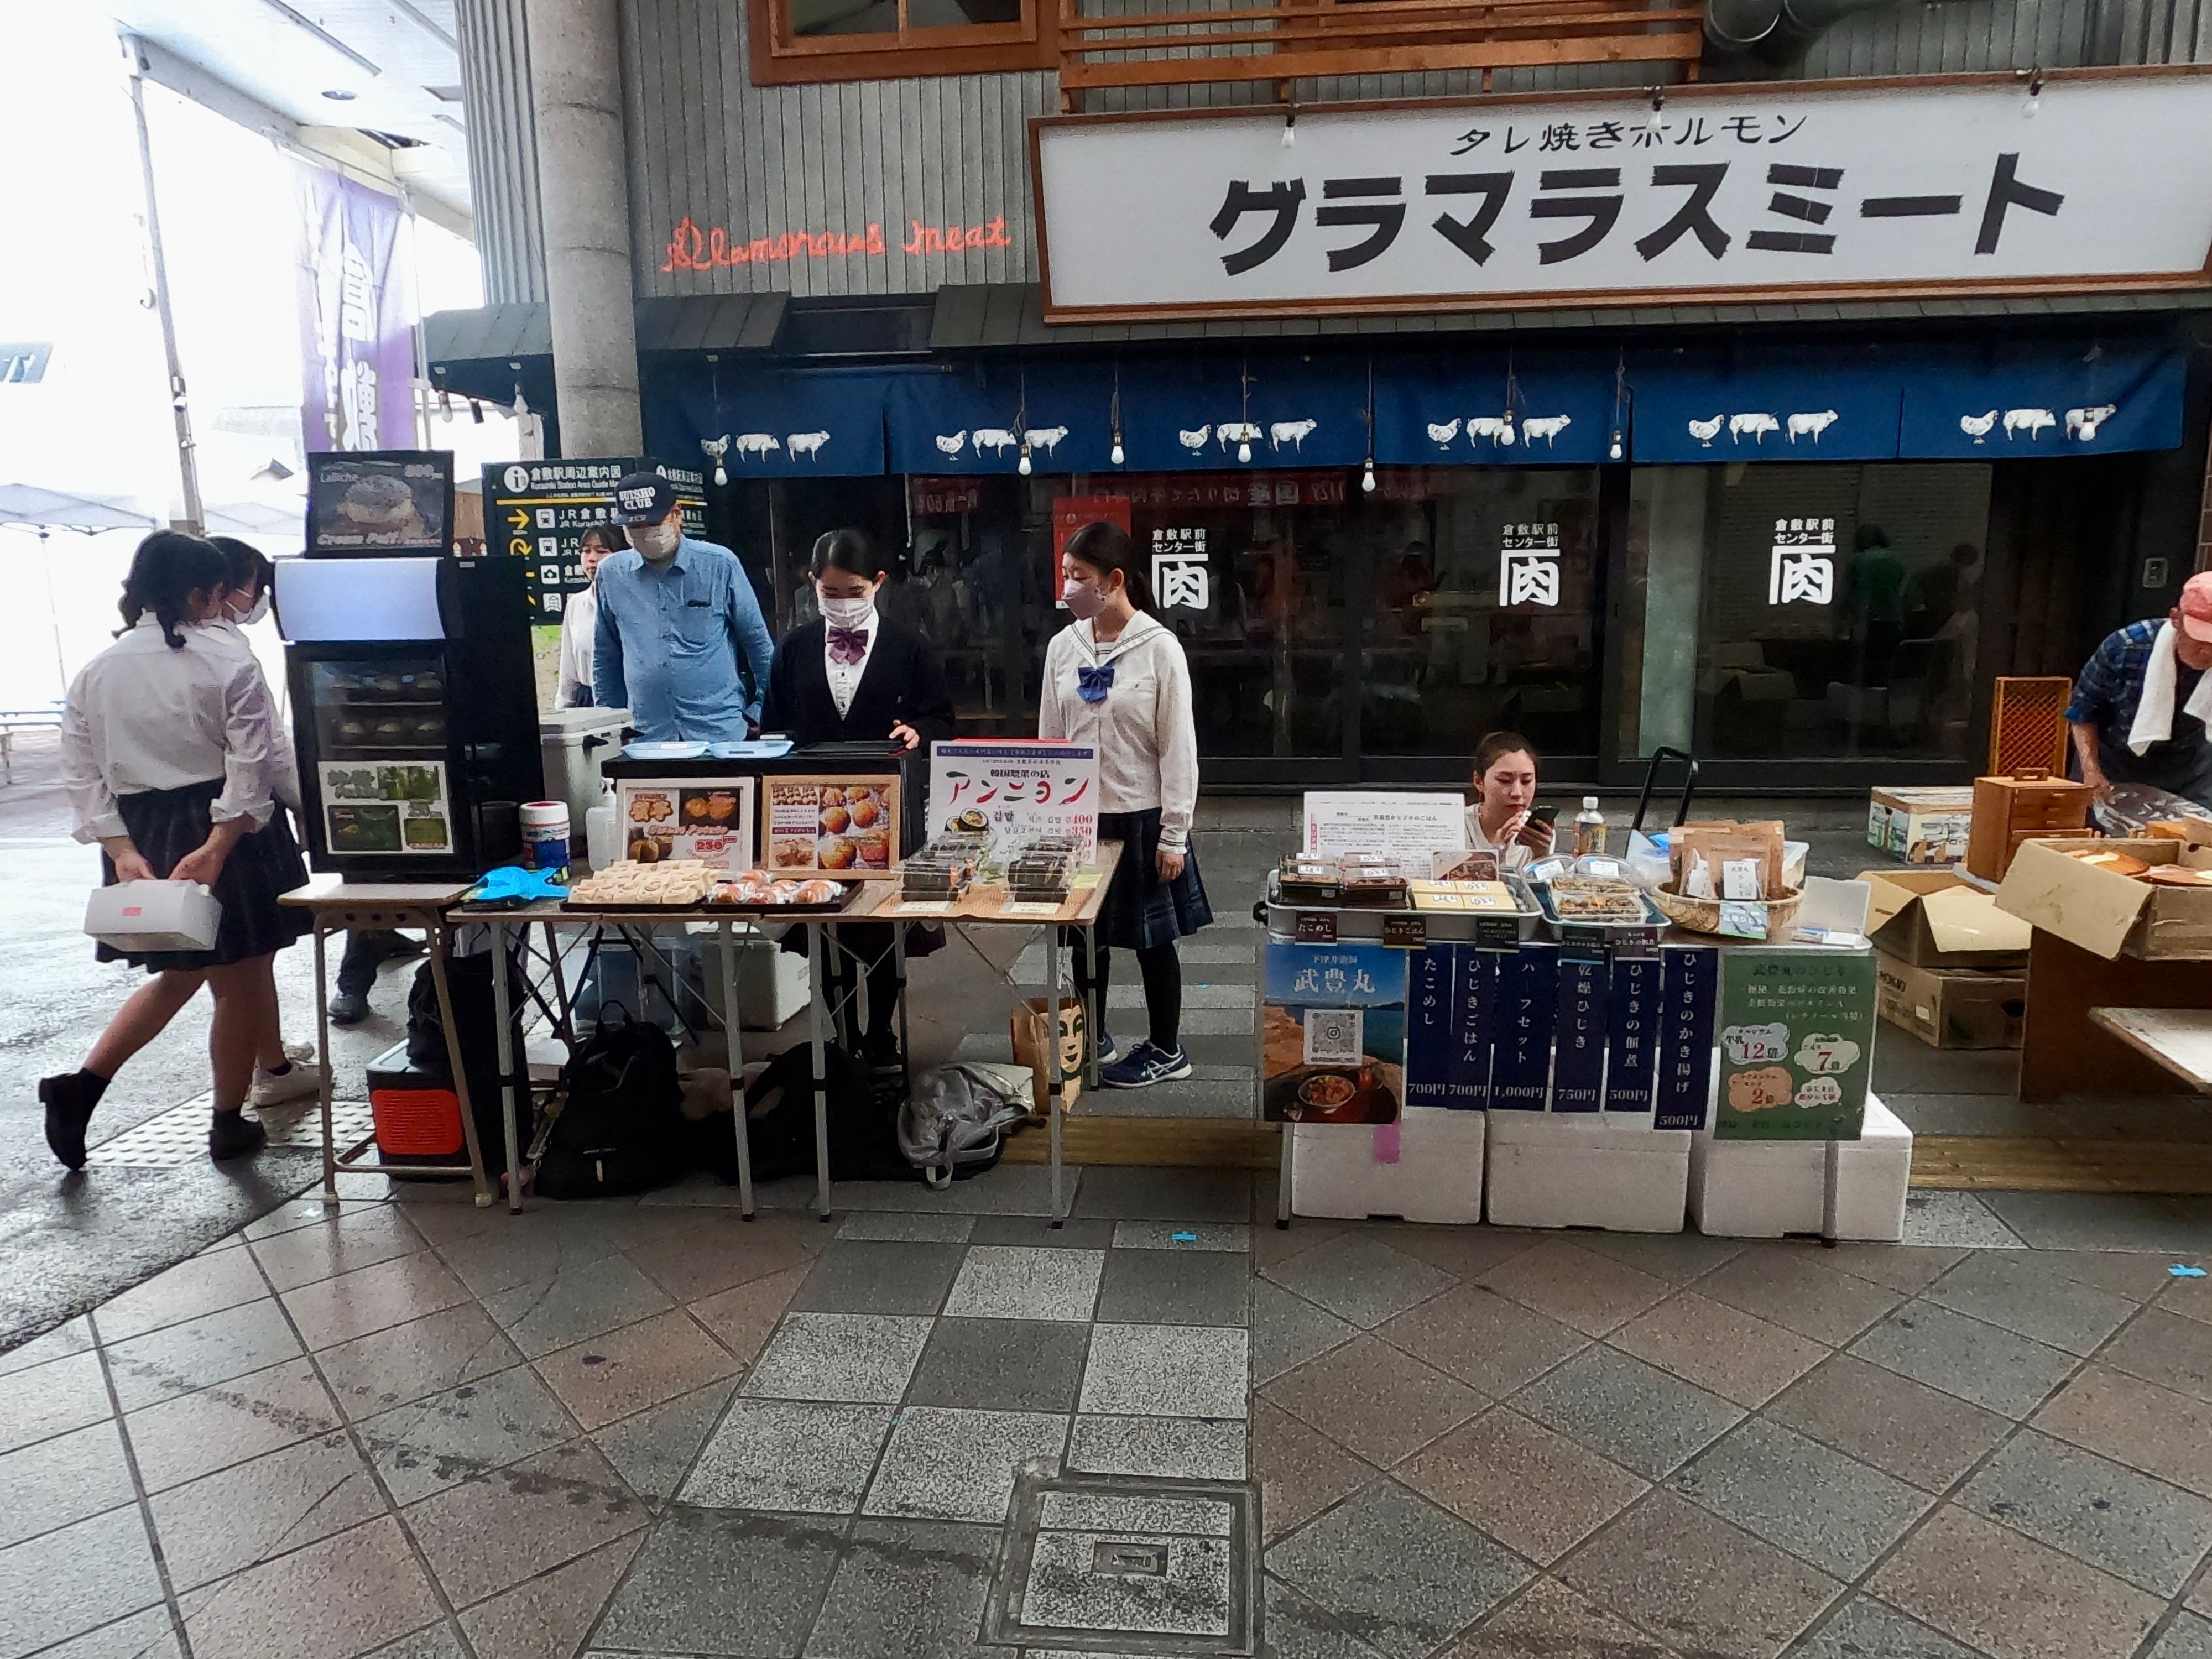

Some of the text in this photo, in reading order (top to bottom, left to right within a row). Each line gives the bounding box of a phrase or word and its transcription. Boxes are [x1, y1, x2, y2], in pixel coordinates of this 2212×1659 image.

[1450, 113, 1808, 158] タレ焼きホルモン
[1209, 150, 2064, 276] グラマラスミート
[624, 497, 654, 510] CLUB
[1503, 522, 1558, 535] 倉敷駅前
[1775, 518, 1835, 531] 倉敷駅前
[1152, 528, 1206, 541] 倉敷駅前
[1774, 531, 1834, 544] センター街
[1152, 541, 1206, 553] センター街
[1502, 536, 1558, 548] センター街
[1162, 561, 1209, 609] 肉
[1511, 557, 1559, 606] 肉
[1781, 554, 1833, 604] 肉
[946, 771, 1089, 805] アンニョン
[1298, 924, 1332, 932] たこめし
[1423, 958, 1437, 1025] たこめし
[1463, 959, 1481, 1062] ひじきごはん
[1517, 962, 1535, 1064] ハーフセット
[1624, 964, 1642, 1068] ひじきの佃煮
[1676, 954, 1697, 1094] ひじきのかき揚げ
[1408, 1084, 1445, 1095] 700円
[1449, 1084, 1486, 1097] 700円
[1494, 1086, 1543, 1098] 1,000円
[1558, 1088, 1596, 1101] 750円
[1609, 1089, 1648, 1102] 500円
[1660, 1114, 1698, 1127] 500円
